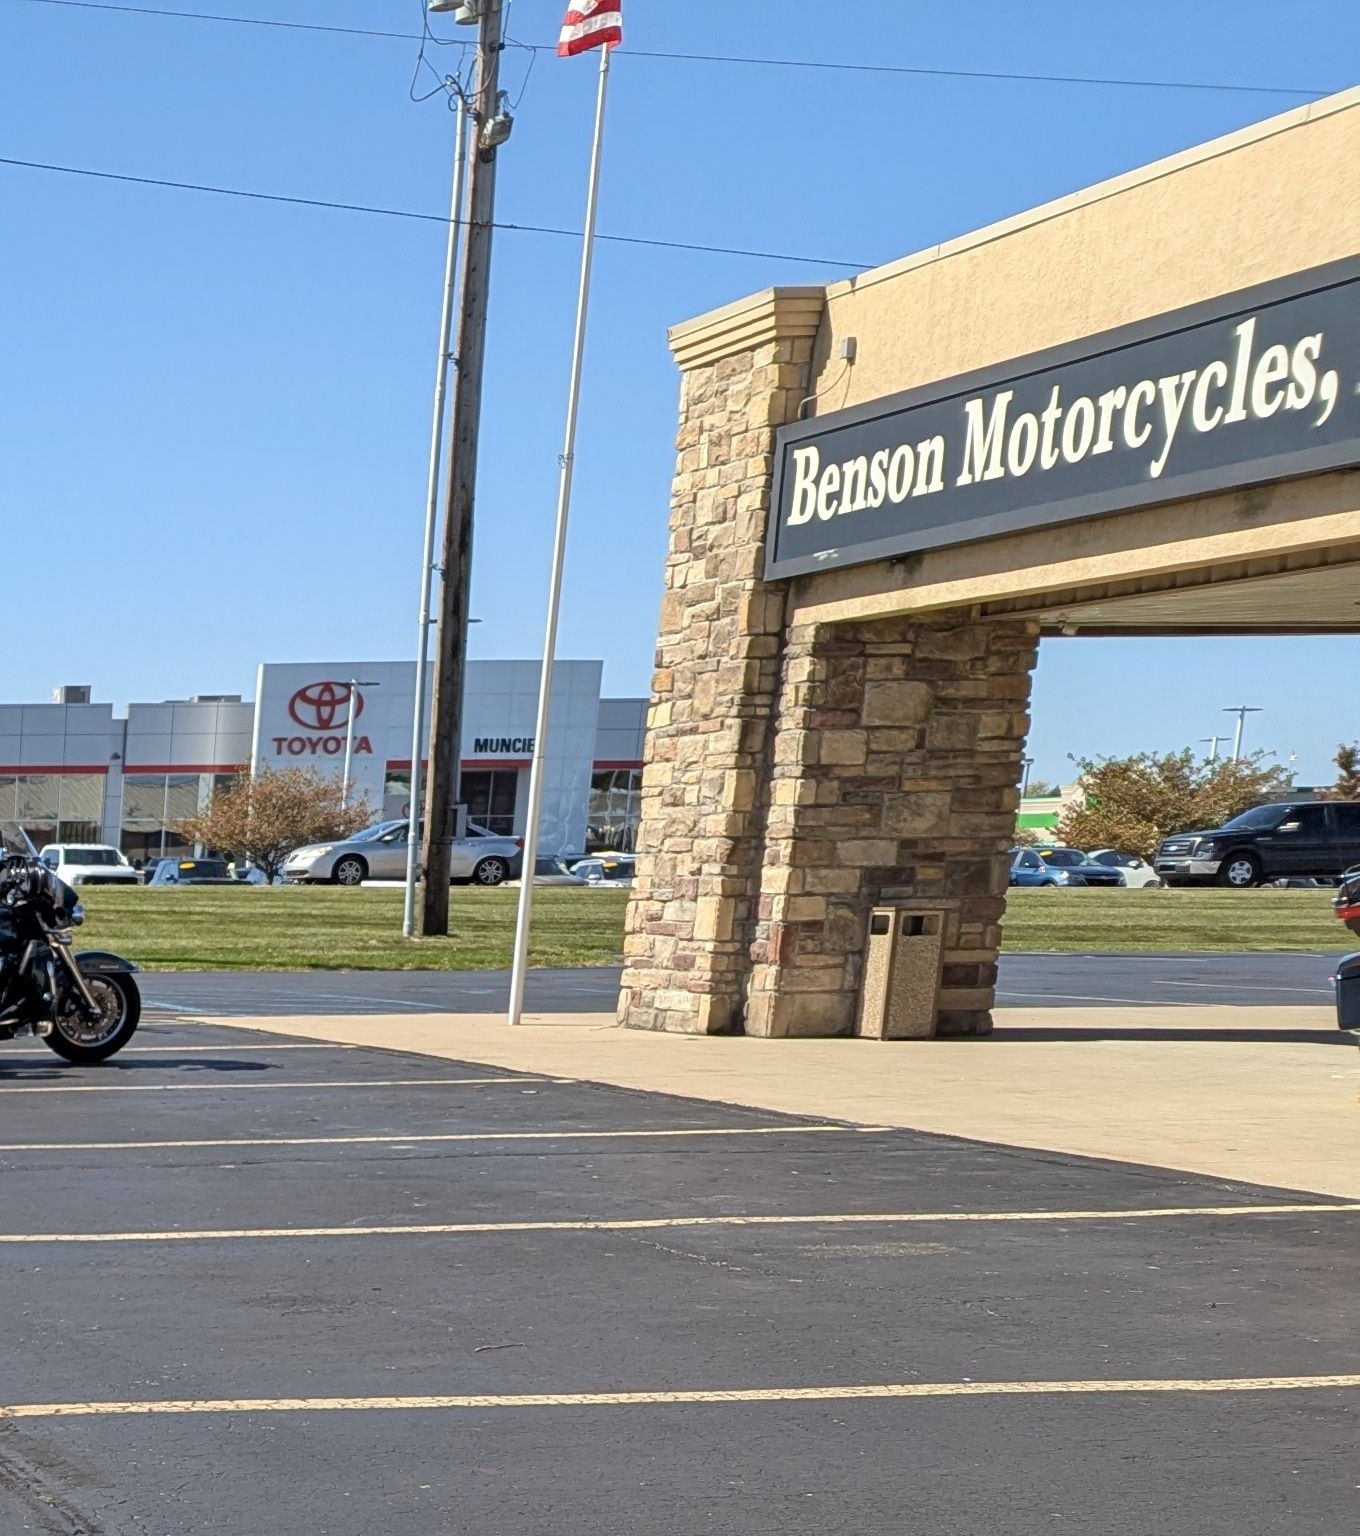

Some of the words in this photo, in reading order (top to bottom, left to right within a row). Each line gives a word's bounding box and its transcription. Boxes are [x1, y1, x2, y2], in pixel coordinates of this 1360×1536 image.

[787, 434, 945, 526] Benson
[957, 316, 1339, 486] Motorcycles,
[473, 737, 536, 754] MUNCIE
